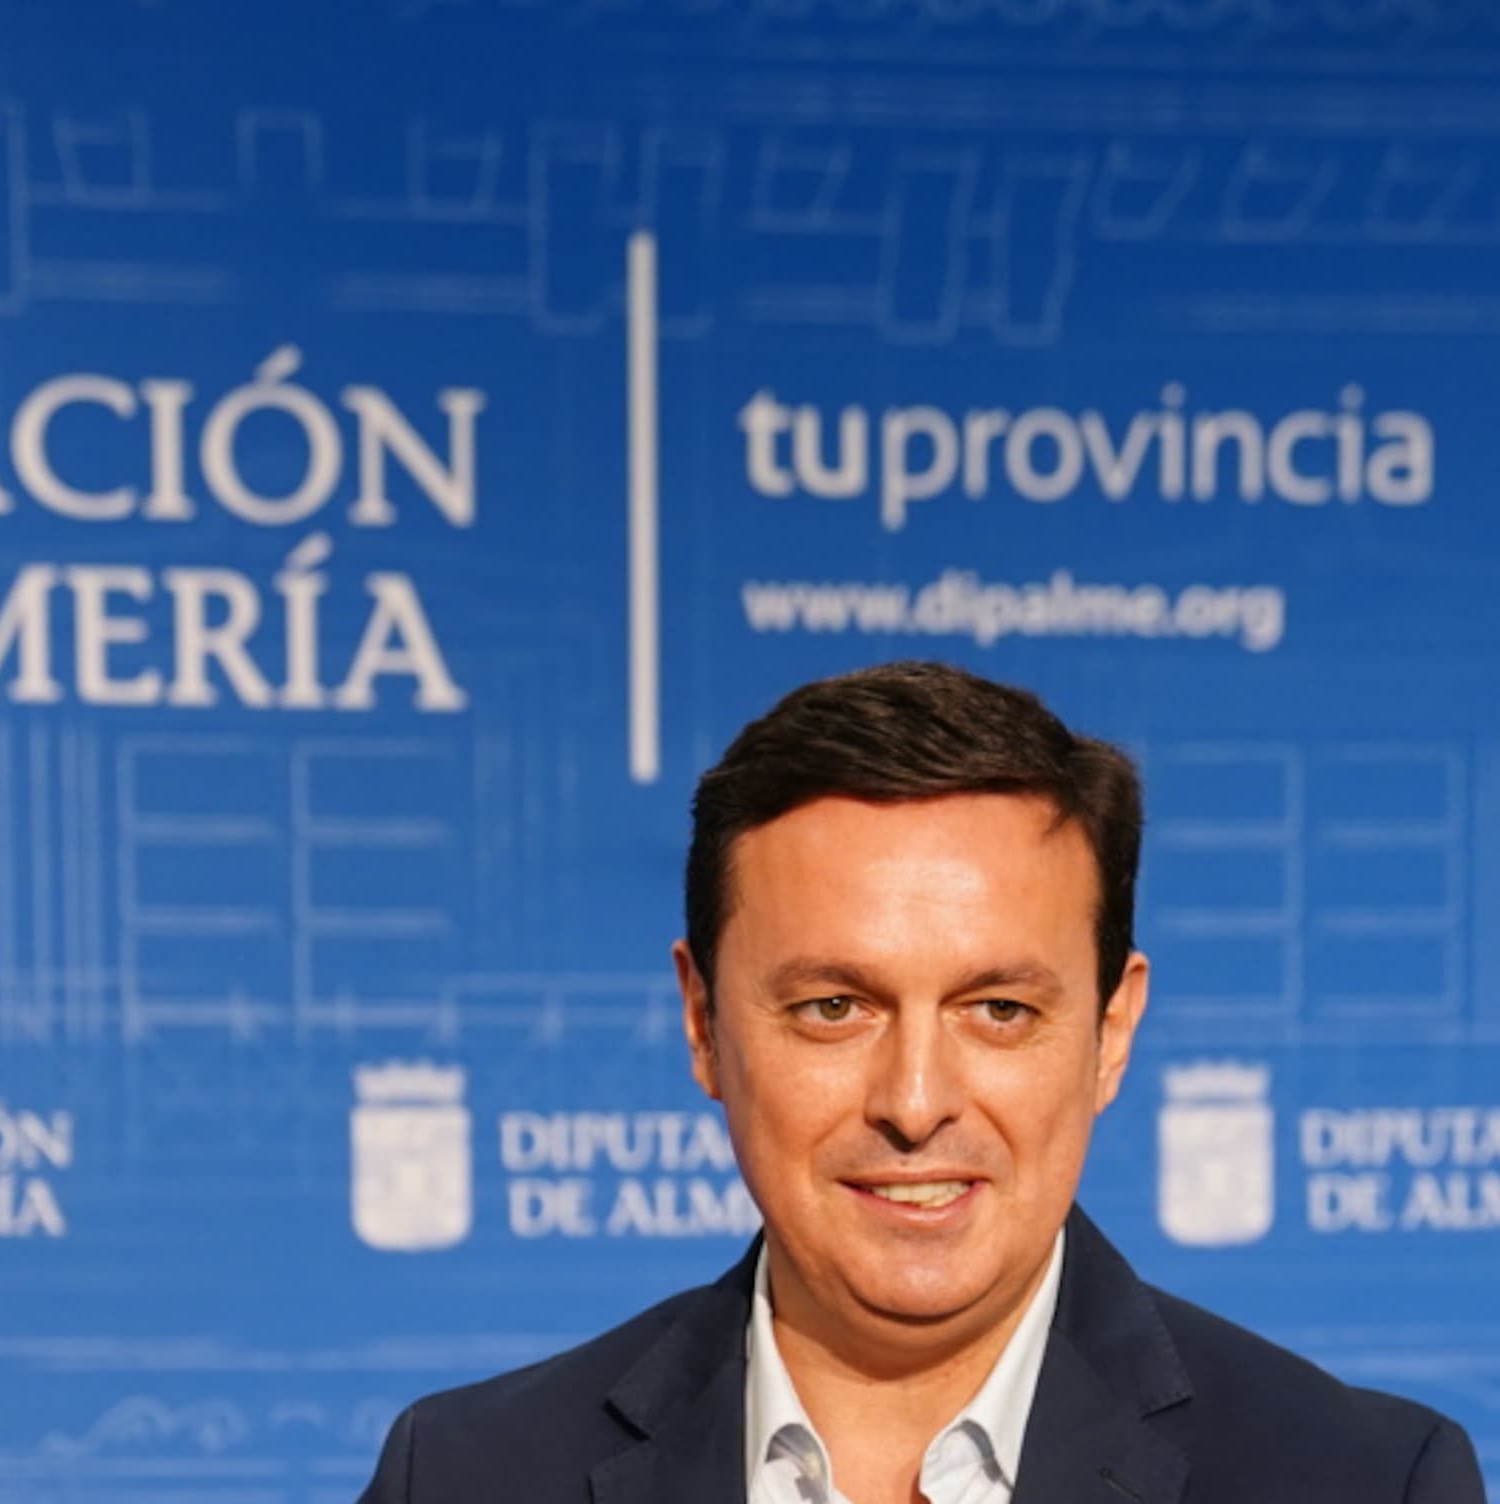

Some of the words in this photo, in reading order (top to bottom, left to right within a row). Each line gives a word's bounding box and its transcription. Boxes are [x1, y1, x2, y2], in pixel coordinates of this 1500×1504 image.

[743, 570, 1285, 652] www.dipalme.org
[500, 1111, 737, 1173] DIPUTA
[507, 1178, 596, 1238] DE
[1308, 1171, 1392, 1233] DE
